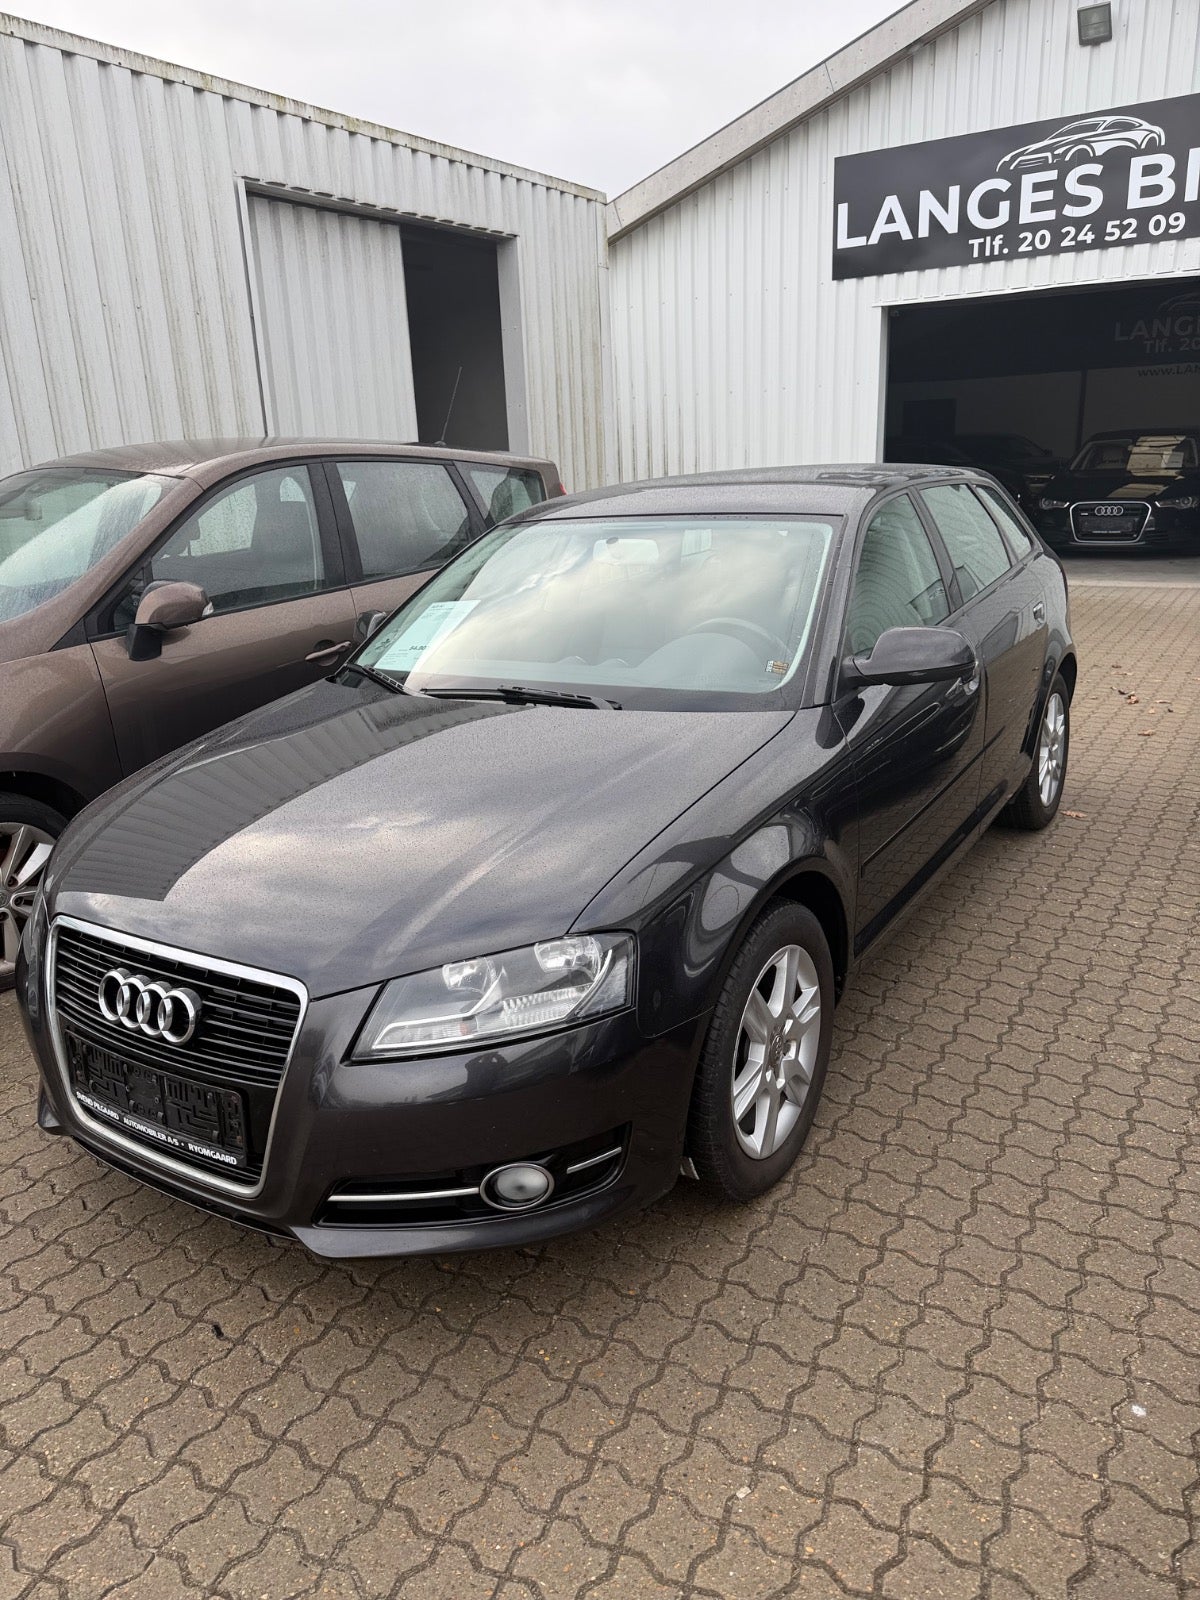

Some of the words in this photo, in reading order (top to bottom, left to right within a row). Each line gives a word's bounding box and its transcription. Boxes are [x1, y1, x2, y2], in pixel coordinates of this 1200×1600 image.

[836, 163, 1105, 250] LANGES
[968, 234, 1009, 259] Tlf.
[1018, 229, 1051, 253] 20
[1060, 223, 1095, 248] 24
[1105, 218, 1138, 242] 52
[1148, 211, 1186, 236] 09
[123, 1117, 167, 1142] AUTOMOBILER
[188, 1143, 238, 1166] RYOMGAARD
